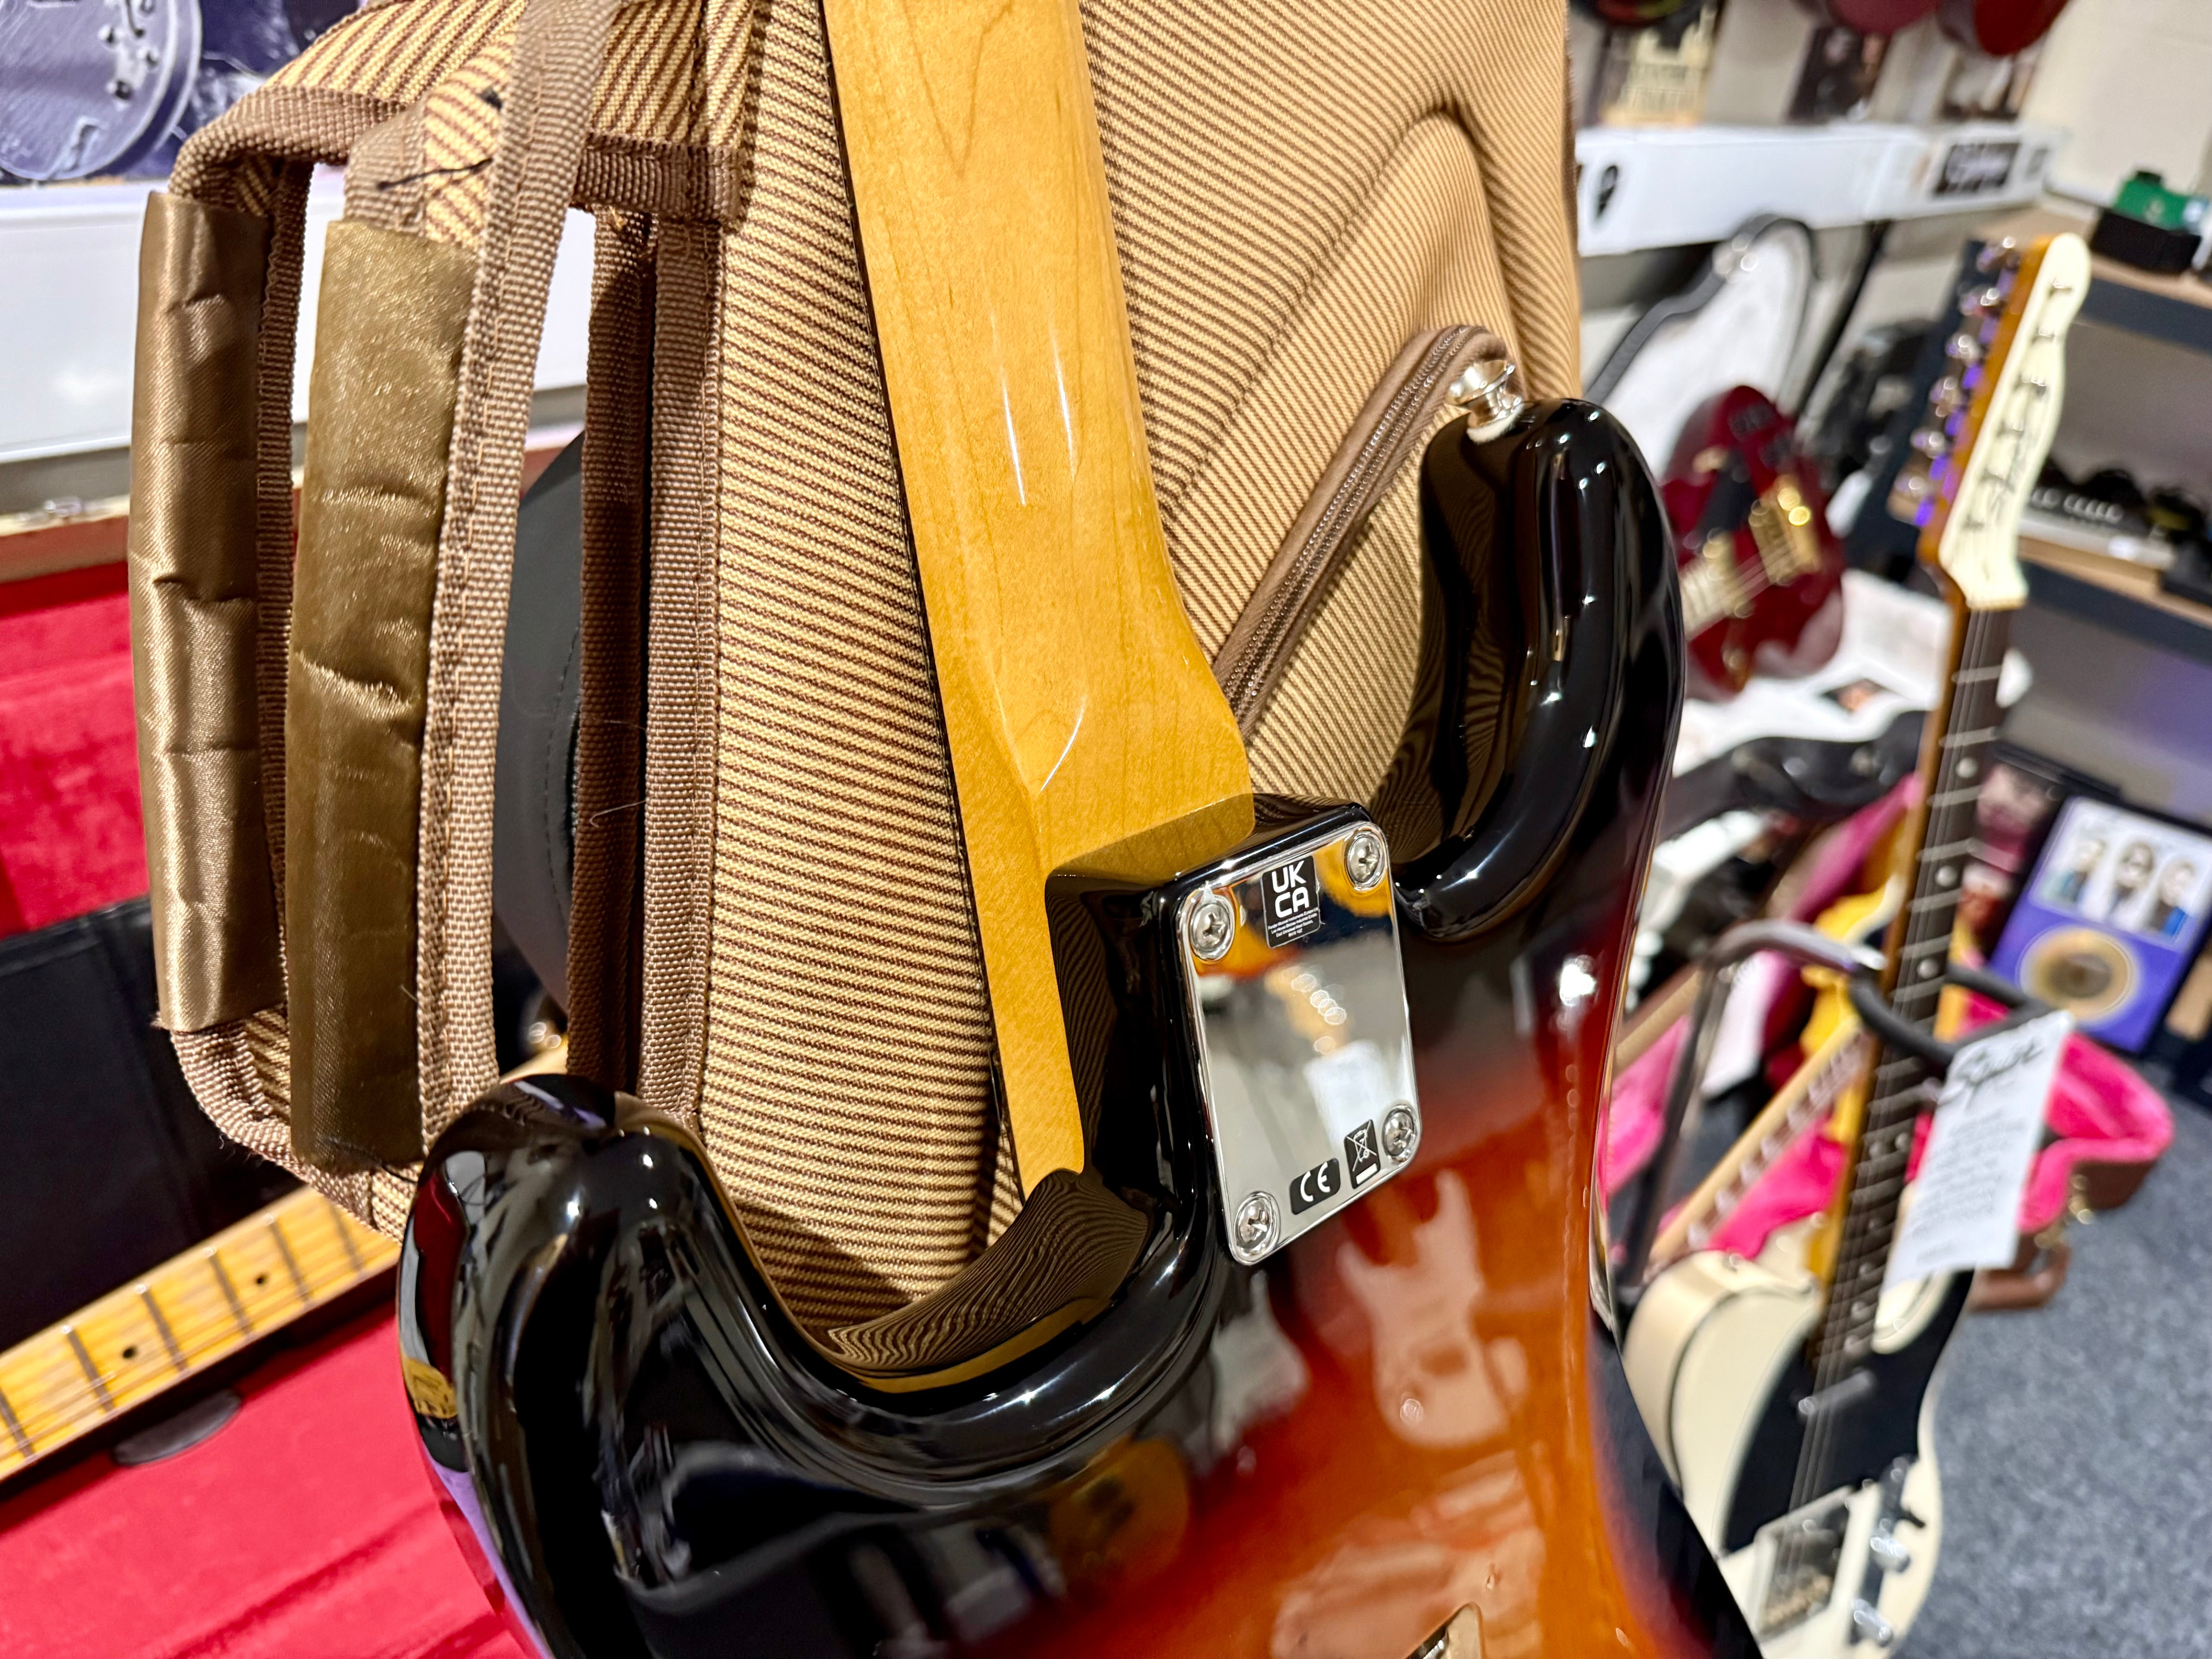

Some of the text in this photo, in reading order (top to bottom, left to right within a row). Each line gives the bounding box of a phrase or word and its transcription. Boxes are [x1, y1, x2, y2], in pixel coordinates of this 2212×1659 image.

[1271, 860, 1307, 893] UK
[1275, 887, 1309, 918] CA
[1300, 1162, 1331, 1202] CE
